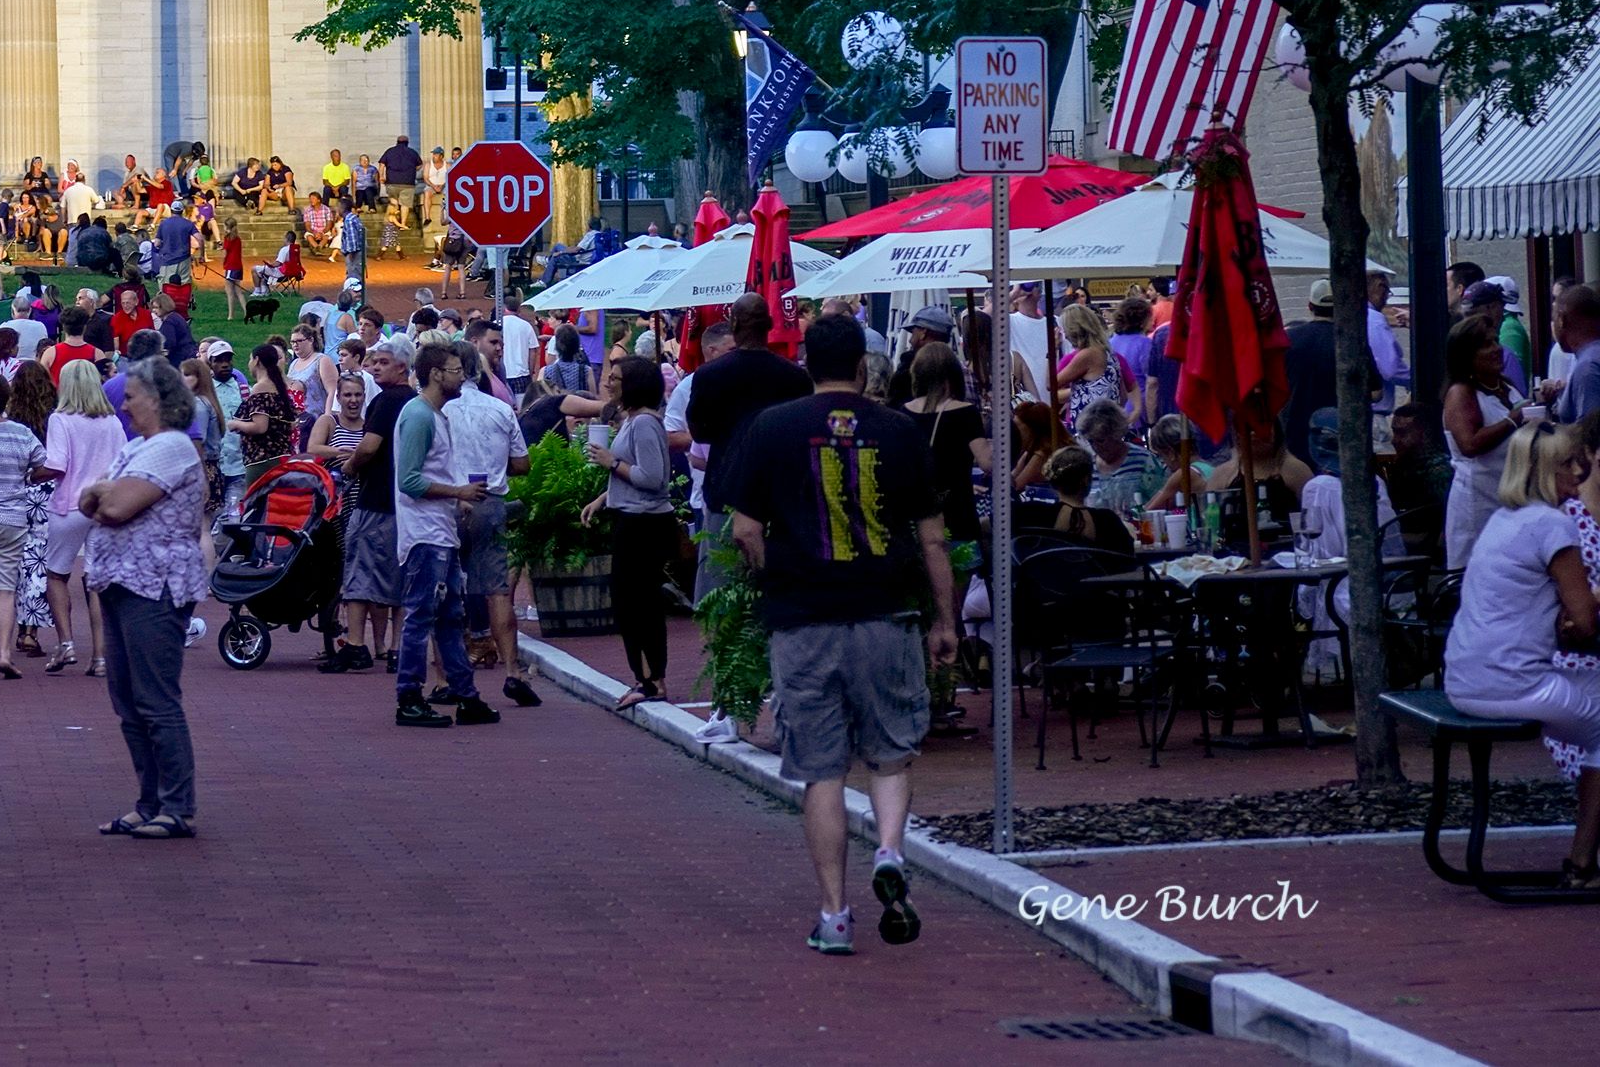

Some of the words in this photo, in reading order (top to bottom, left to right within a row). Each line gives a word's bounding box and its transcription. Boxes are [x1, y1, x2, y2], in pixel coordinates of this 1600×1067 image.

[987, 52, 1017, 76] NO
[963, 82, 1040, 107] PARKING
[983, 114, 1021, 135] ANY
[981, 140, 1025, 162] TIME
[453, 174, 545, 214] STOP
[890, 243, 972, 261] WHEATLEY
[692, 284, 733, 296] BUFFALO
